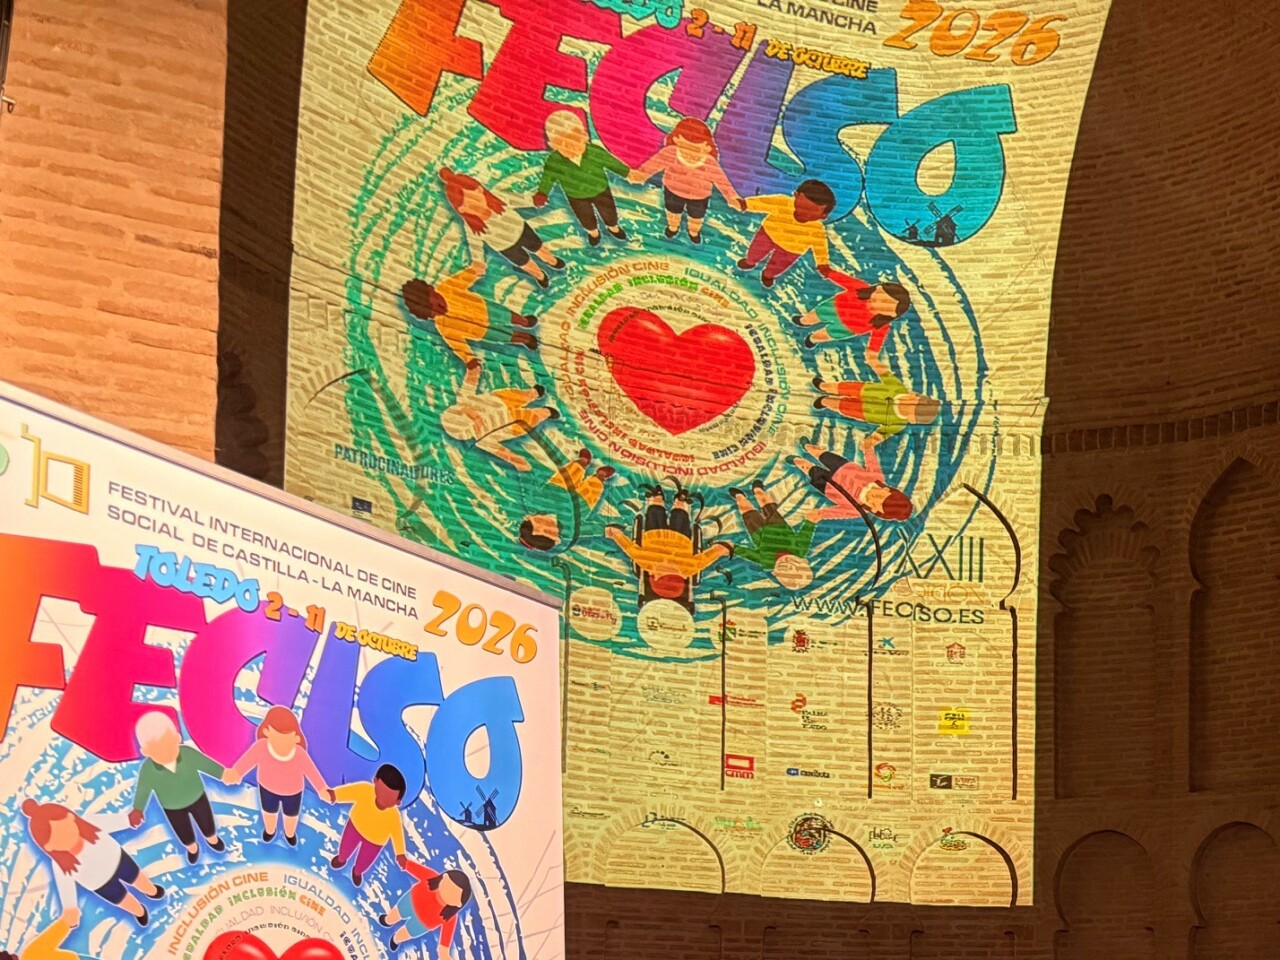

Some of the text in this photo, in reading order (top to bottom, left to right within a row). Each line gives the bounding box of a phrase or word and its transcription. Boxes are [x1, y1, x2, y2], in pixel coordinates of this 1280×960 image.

[686, 9, 709, 38] 2
[731, 22, 757, 51] 11
[786, 2, 877, 35] MANCHA
[883, 0, 1067, 66] 2026
[367, 0, 1018, 248] FECISO
[108, 481, 417, 601] FESTIVAL INTERNACIONAL DE CINE
[108, 505, 184, 541] SOCIAL
[193, 533, 218, 553] DE
[222, 544, 310, 584] CASTILLA
[321, 577, 344, 595] LA
[347, 587, 419, 620] MANCHA
[894, 527, 984, 583] XXIII
[133, 543, 261, 613] TOLEDO
[264, 591, 284, 622] 2
[304, 604, 326, 634] 11
[334, 621, 357, 642] DE
[357, 629, 419, 661] OCTUBRE
[424, 588, 538, 665] 2026
[0, 533, 525, 831] FECISO
[169, 879, 231, 956] INCLUSIÓN
[232, 871, 270, 887] CINE
[228, 886, 298, 908] INCLUSIÓN
[299, 893, 327, 917] CINE
[283, 873, 351, 925] IGUALDAD
